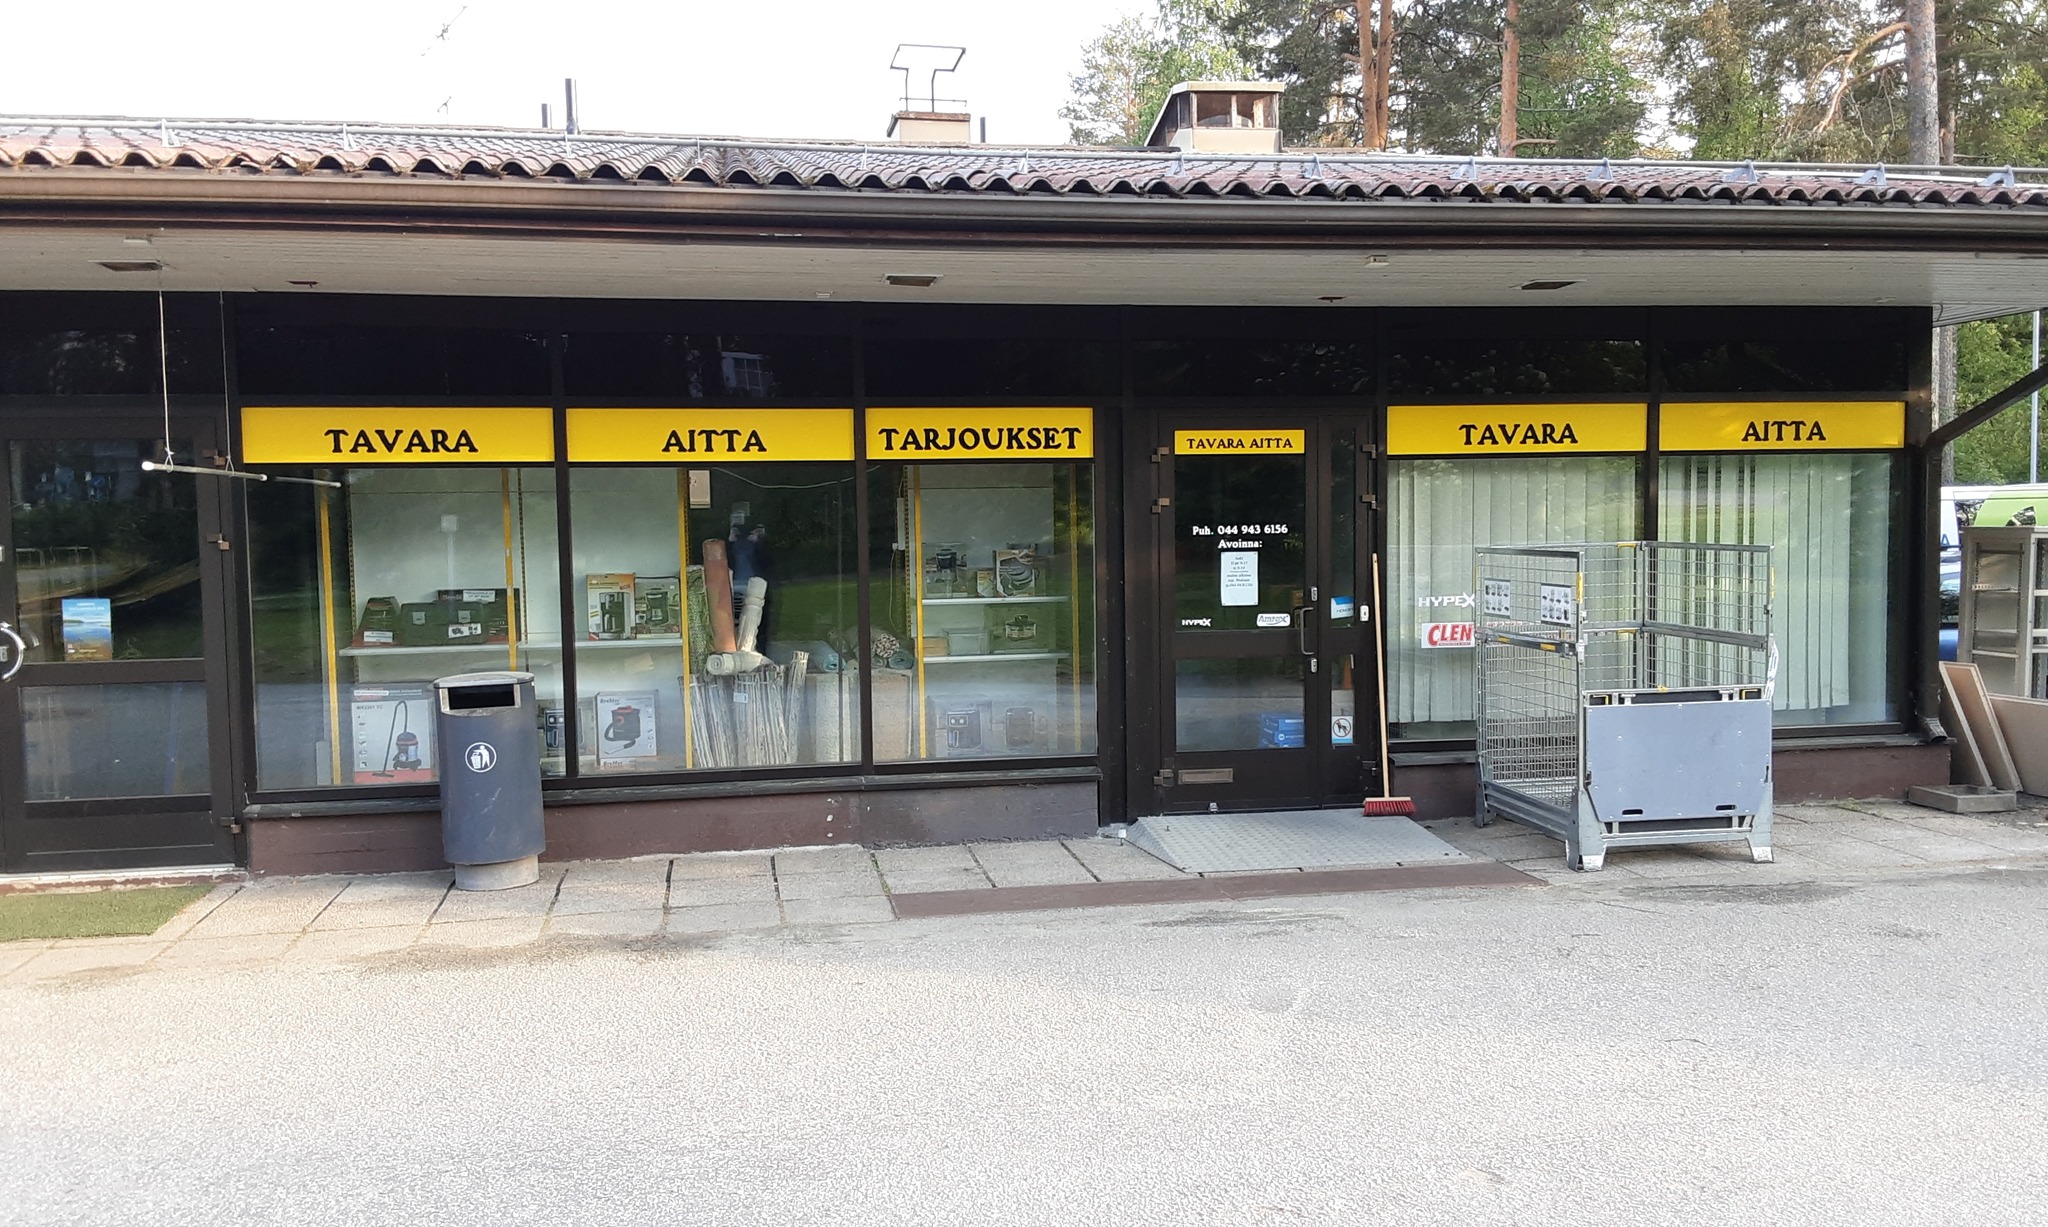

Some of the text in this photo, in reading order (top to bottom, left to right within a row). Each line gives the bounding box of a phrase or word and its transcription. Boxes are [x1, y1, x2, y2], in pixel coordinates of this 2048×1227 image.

[324, 429, 479, 453] TAVARA
[661, 429, 767, 453] AITTA
[878, 427, 1082, 451] TARJOUKSET
[1458, 423, 1579, 446] TAVARA
[1741, 420, 1827, 442] AITTA
[1186, 437, 1293, 449] TAVARA AITTA
[1192, 524, 1289, 536] Puh. 044 943 6156
[1217, 539, 1263, 549] Avoinna:
[1418, 592, 1475, 608] HYPEX
[1181, 617, 1212, 627] HYPEX
[1427, 624, 1473, 646] CLEN
